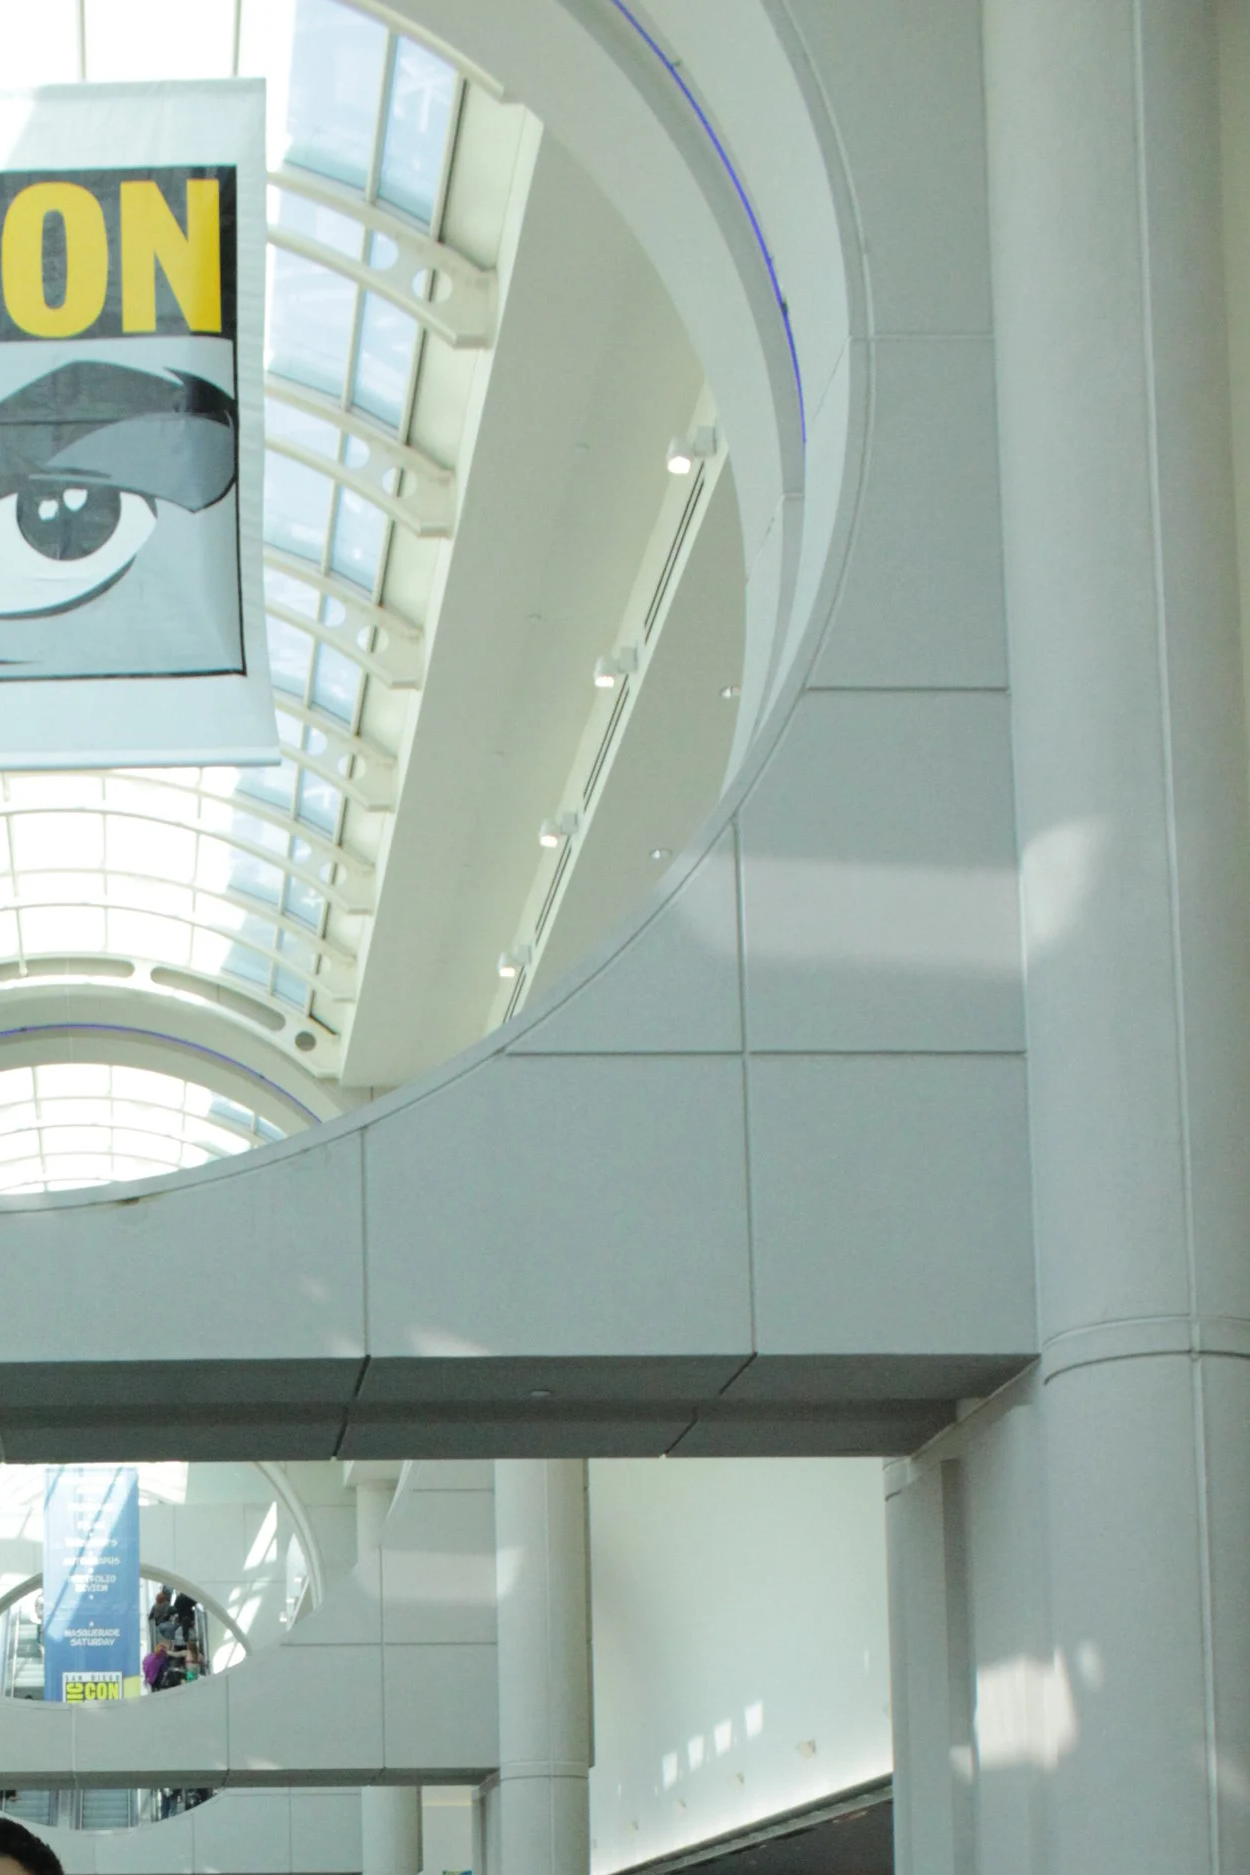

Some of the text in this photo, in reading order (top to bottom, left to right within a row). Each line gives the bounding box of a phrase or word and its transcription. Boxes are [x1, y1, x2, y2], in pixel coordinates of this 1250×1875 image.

[64, 1628, 121, 1638] MASQUERADE
[70, 1638, 116, 1647] SATURDAY
[84, 1682, 119, 1700] CON
